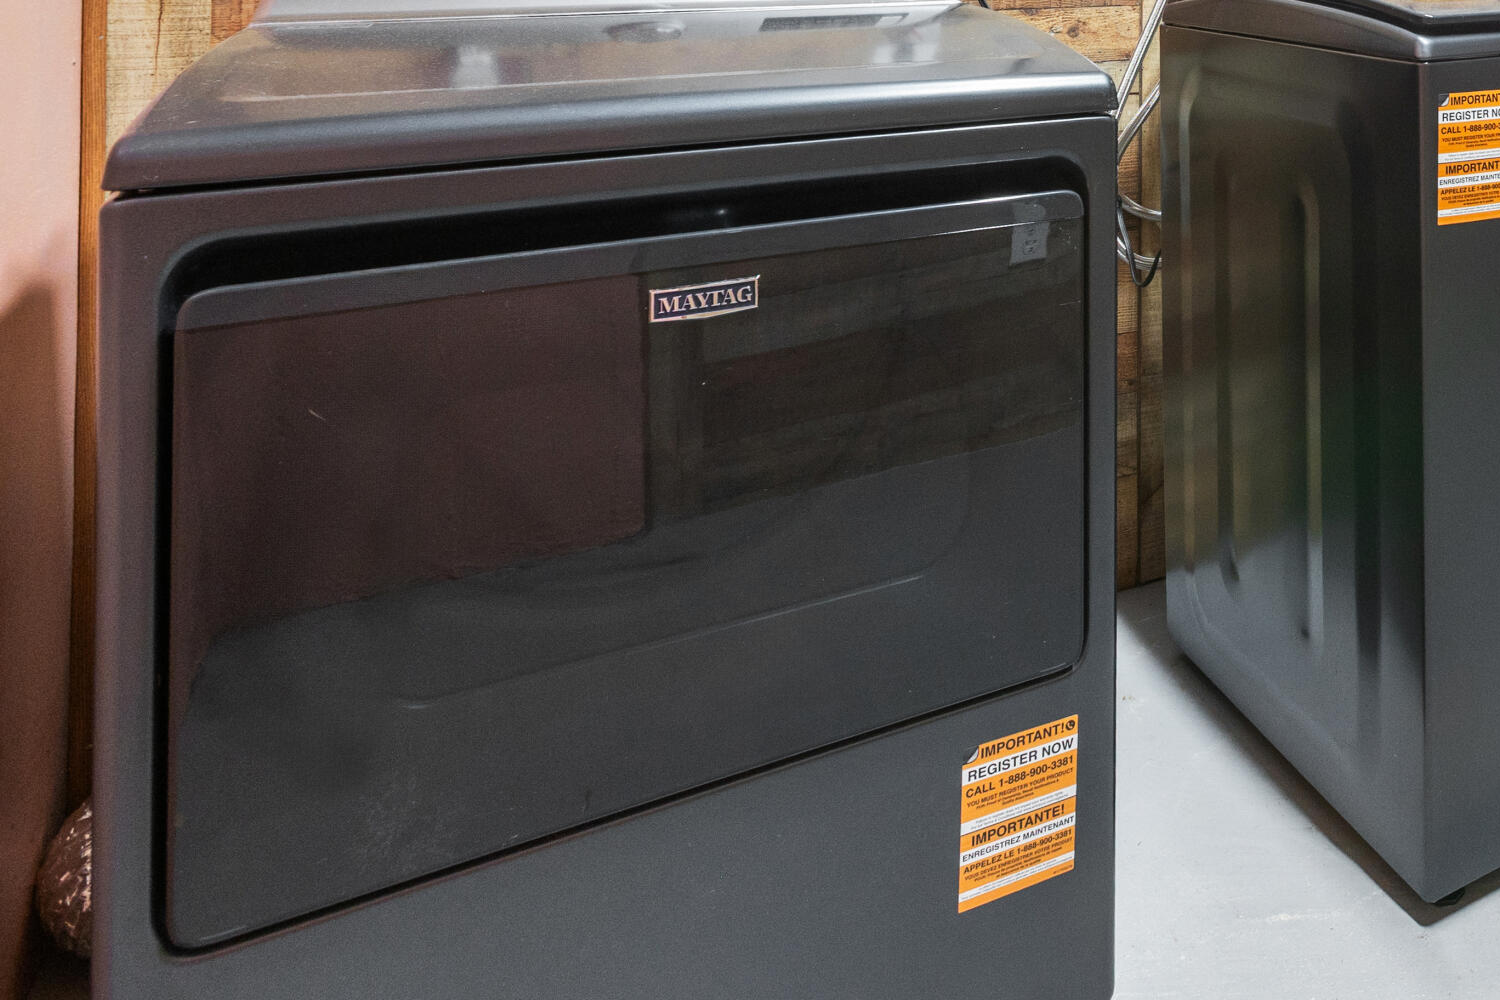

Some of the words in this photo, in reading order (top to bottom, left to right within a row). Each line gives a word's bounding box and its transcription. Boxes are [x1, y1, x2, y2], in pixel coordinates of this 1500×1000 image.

[1441, 126, 1462, 135] CALL
[1442, 110, 1489, 122] REGISTER
[1440, 175, 1479, 186] ENREGISTREZ
[1440, 186, 1467, 195] APPELEZ
[658, 285, 753, 314] MAYTAG
[968, 750, 1038, 782] REGISTER
[1042, 738, 1074, 758] NOW
[980, 722, 1065, 760] IMPORTANT!
[966, 782, 996, 799] CALL
[999, 755, 1074, 788] 1-888-900-3381
[962, 835, 1021, 862] ENREGISTREZ
[1022, 816, 1074, 840] MAINTENANT
[972, 804, 1064, 846] IMPORTANTE!
[964, 856, 1002, 874] APPELEZ
[1004, 850, 1015, 860] LE
[1017, 830, 1072, 854] 1-888-900-3381
